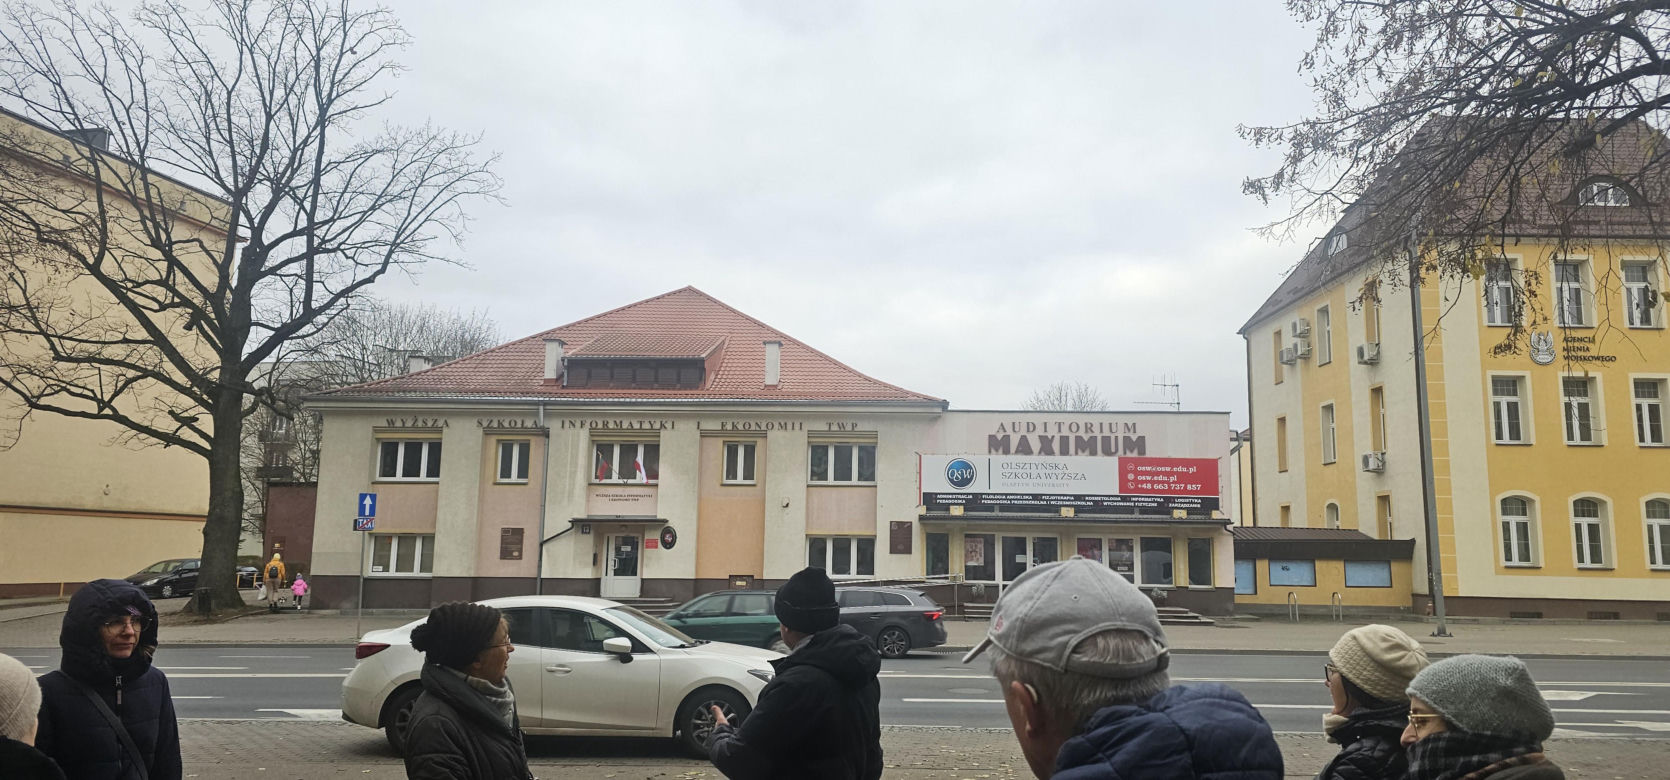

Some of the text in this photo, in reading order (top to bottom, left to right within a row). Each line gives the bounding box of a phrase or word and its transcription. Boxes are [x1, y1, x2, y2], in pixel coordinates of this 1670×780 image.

[386, 416, 858, 431] WYŻSZA SZKOŁA INFORMATYKI I EKONOMII TWP
[996, 421, 1137, 434] AUDITORIUM
[988, 434, 1146, 456] MAXIMUM
[1001, 461, 1069, 471] OLSZTYŃSKA
[1137, 465, 1196, 473] osw@osw.edu.pl
[1001, 472, 1087, 480] SZKOŁA WYŻSZA
[358, 519, 374, 529] TAXI
